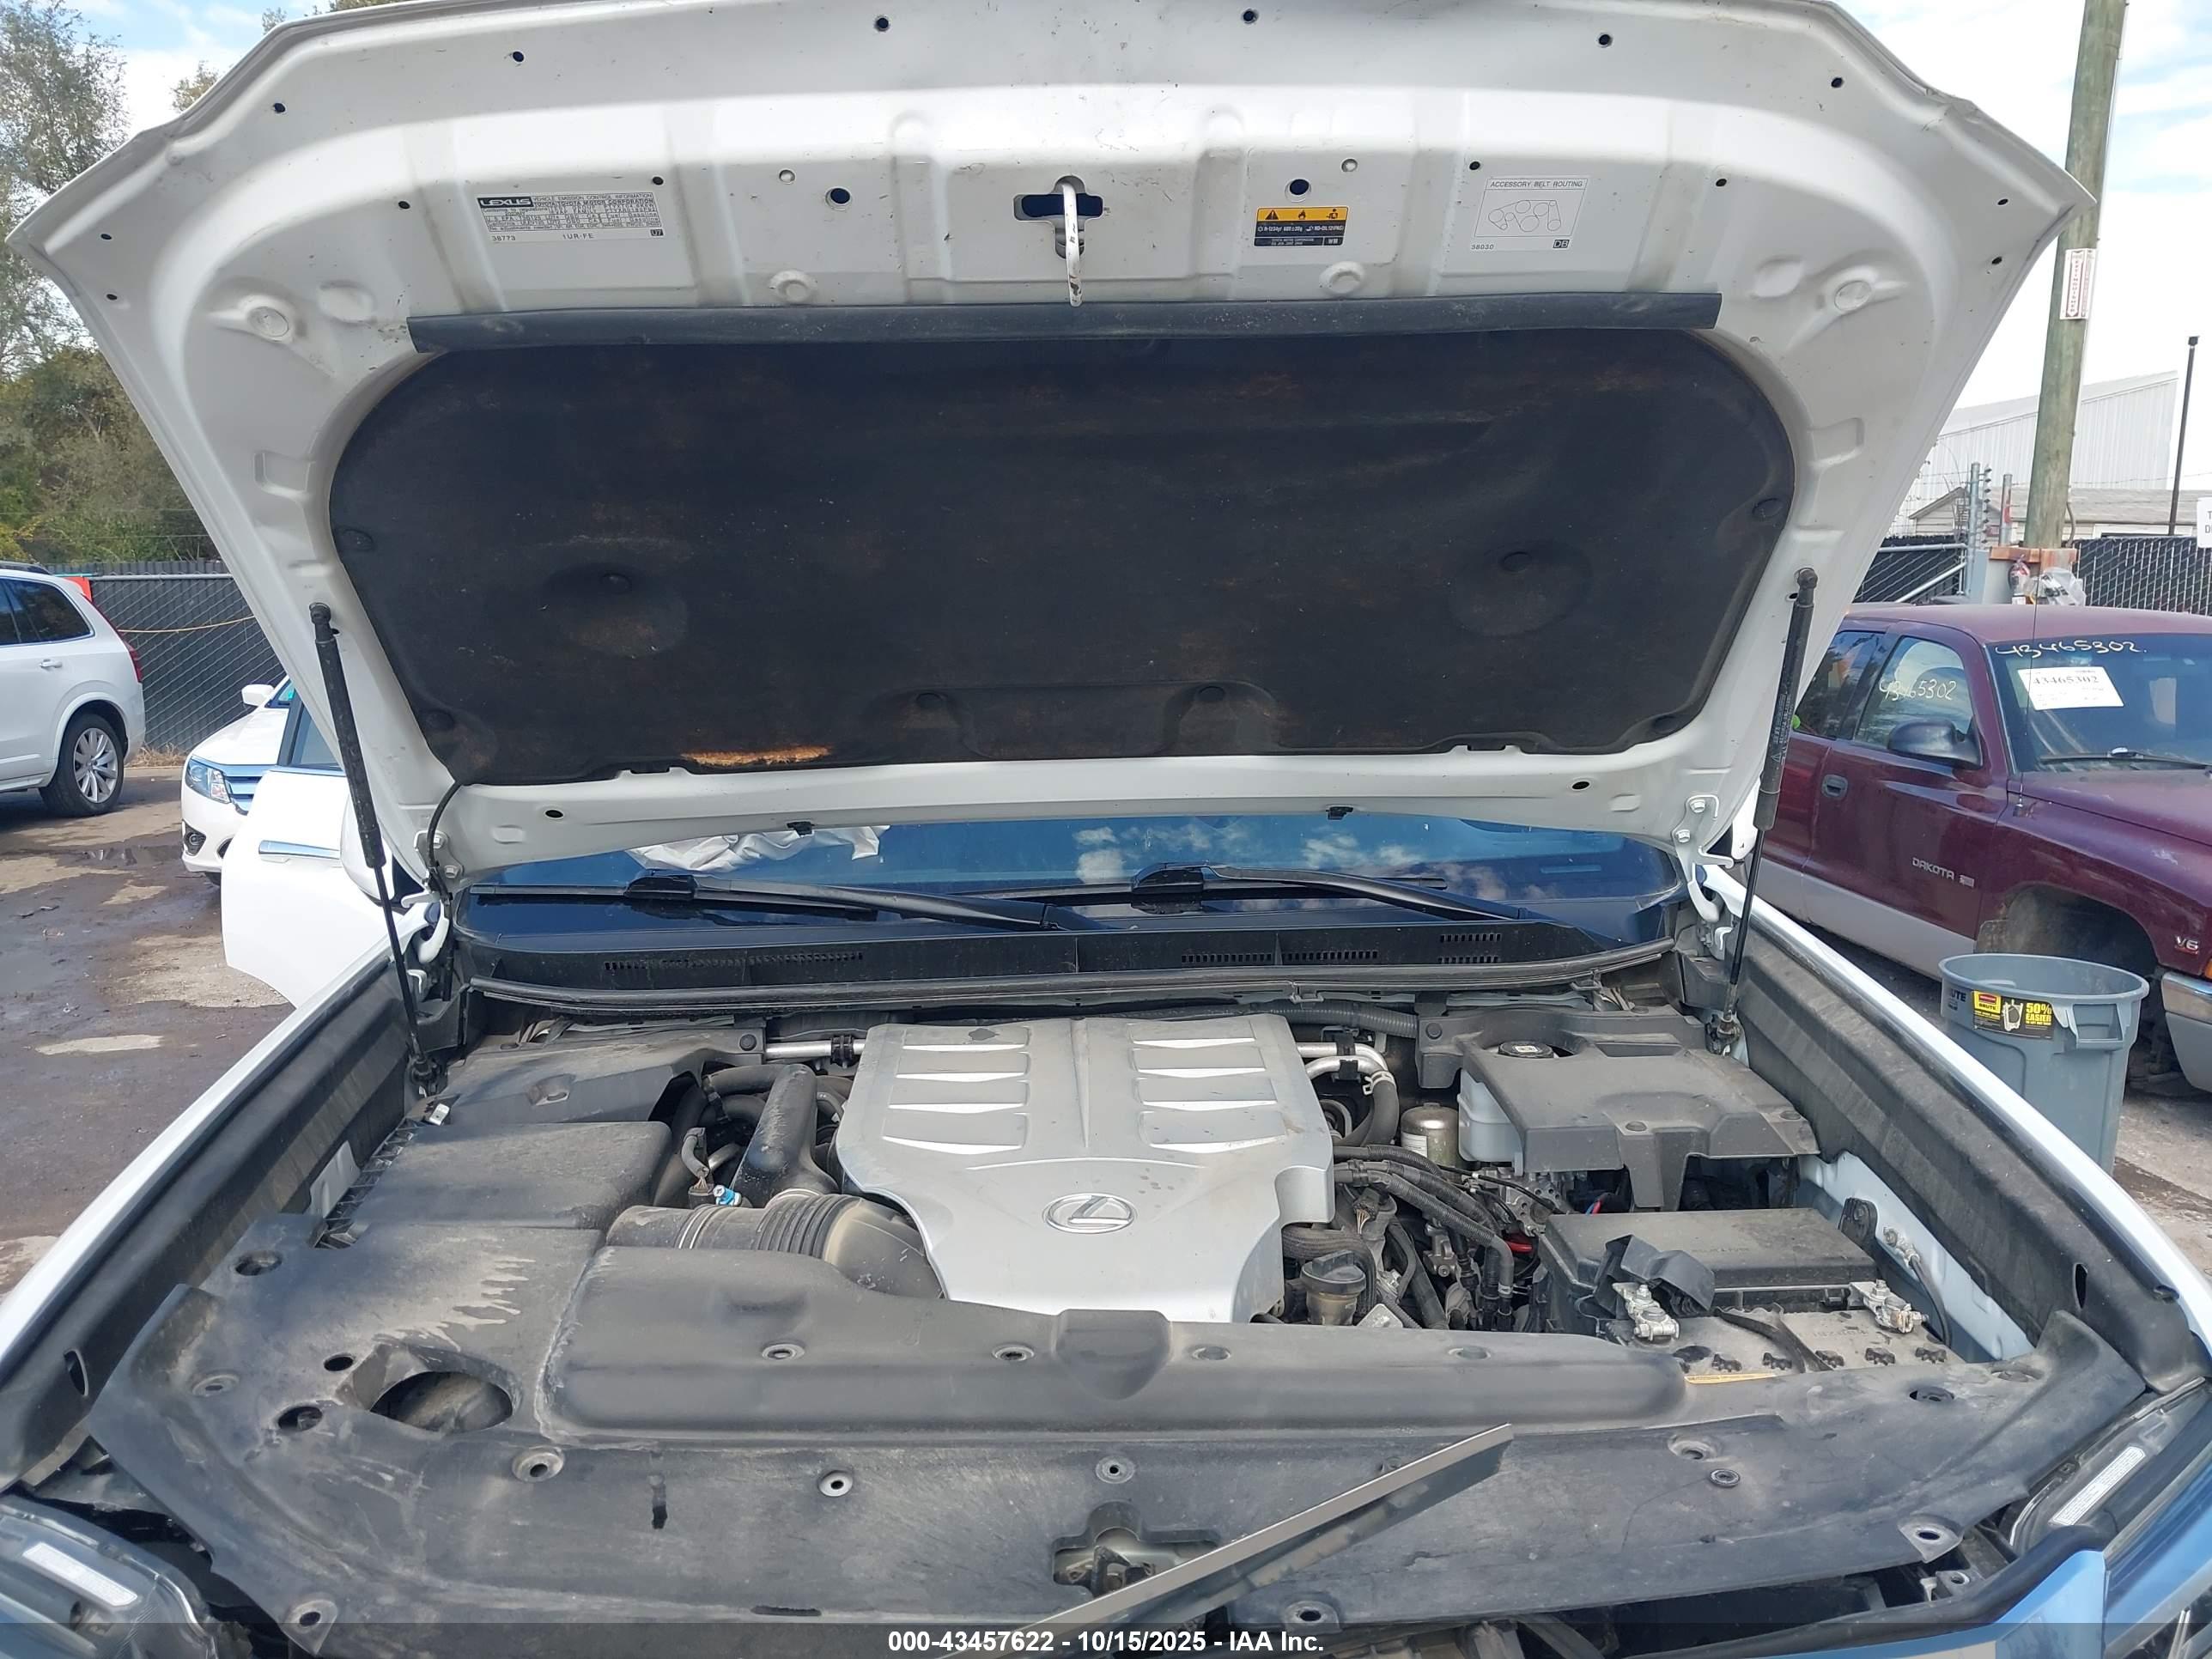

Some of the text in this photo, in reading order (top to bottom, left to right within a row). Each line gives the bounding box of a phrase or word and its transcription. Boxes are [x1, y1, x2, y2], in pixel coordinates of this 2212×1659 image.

[479, 198, 532, 207] LEXUS
[1912, 857, 1954, 880] DAKOTA
[2176, 936, 2198, 951] V6
[2026, 1003, 2052, 1015] 50%
[2026, 1013, 2052, 1023] EASIER
